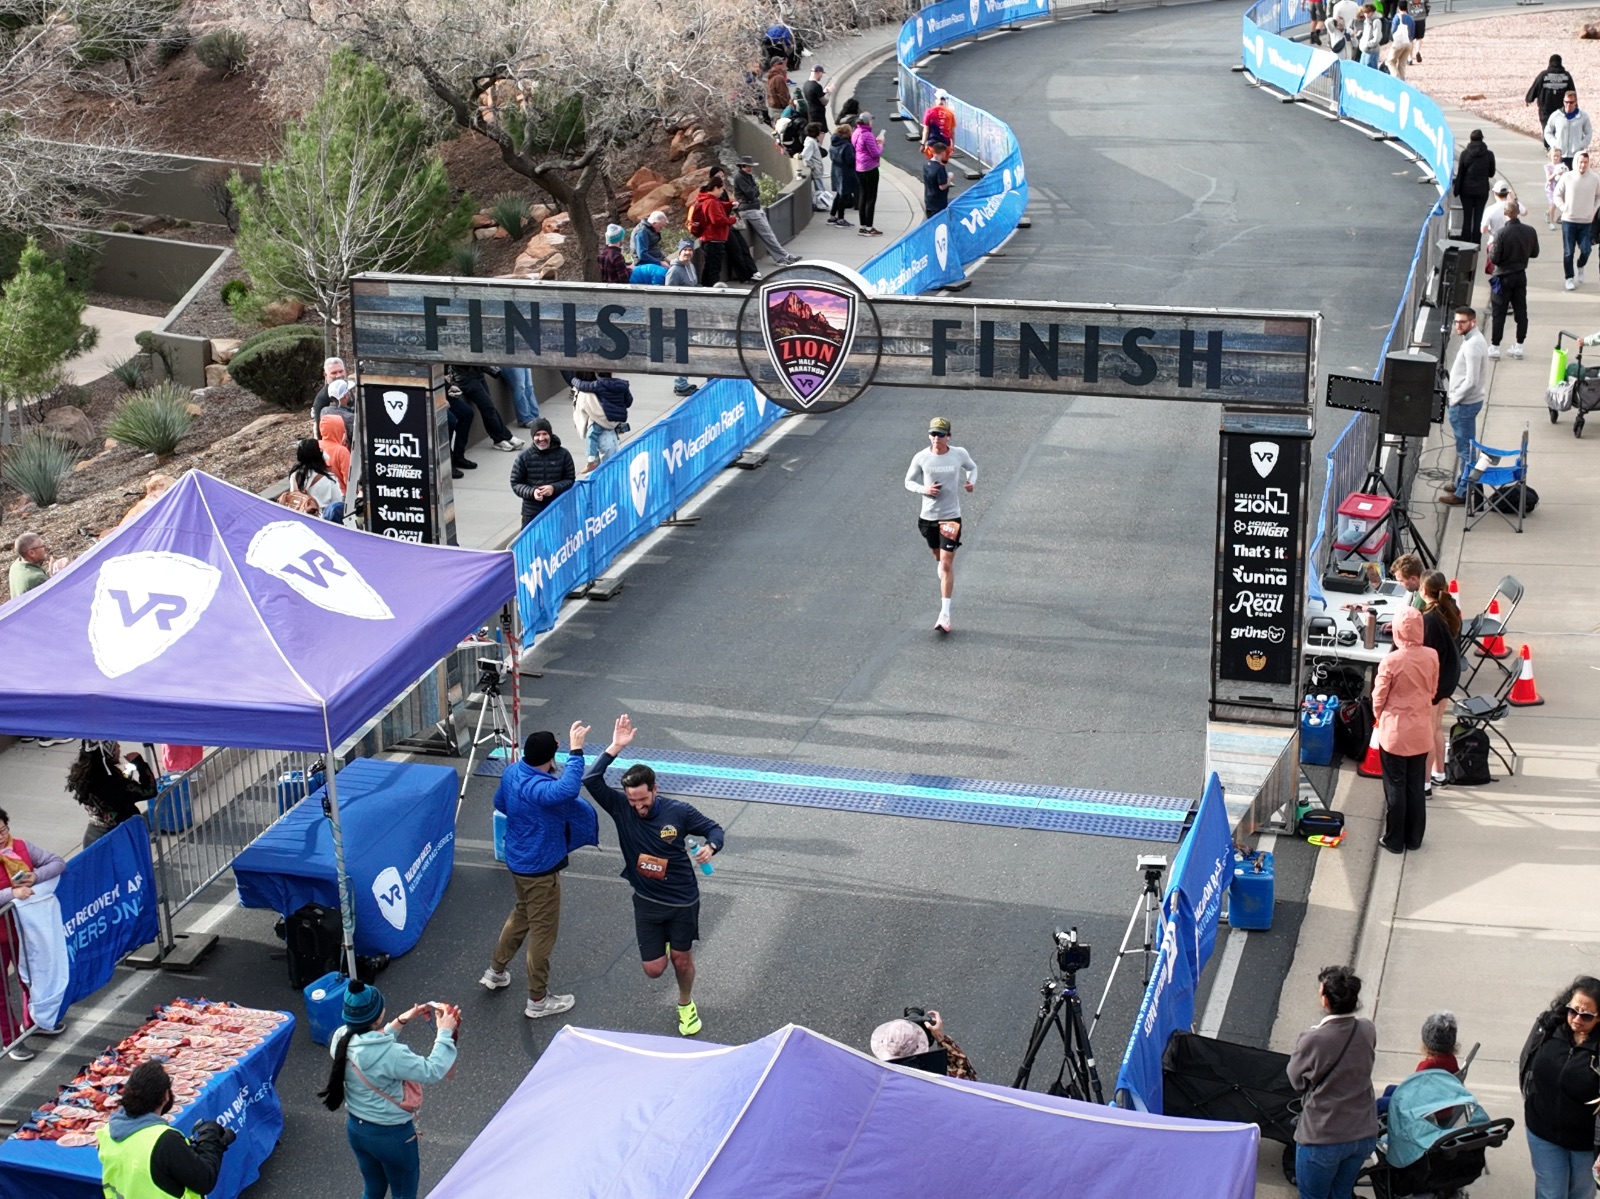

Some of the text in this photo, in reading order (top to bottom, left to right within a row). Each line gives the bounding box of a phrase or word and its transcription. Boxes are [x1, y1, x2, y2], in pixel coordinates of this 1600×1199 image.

[960, 208, 986, 234] VR
[937, 239, 946, 252] VR
[911, 254, 928, 278] Races
[424, 296, 689, 364] FINISH
[780, 340, 834, 362] ZION
[931, 319, 1223, 389] FINISH
[798, 358, 815, 366] HALF
[788, 366, 826, 376] MARATHON
[797, 378, 814, 388] VR
[387, 400, 403, 410] VR
[662, 401, 745, 474] VR Vacation Races
[374, 444, 412, 457] ZION
[1254, 452, 1273, 462] VR
[386, 469, 422, 479] STINGER
[632, 470, 647, 491] VR
[376, 485, 409, 499] That's
[377, 504, 425, 523] Runna
[1234, 499, 1278, 514] ZION
[1245, 526, 1289, 538] STINGER
[520, 503, 617, 598] VR Vacation Races
[1233, 544, 1271, 559] That's
[281, 549, 347, 588] VR
[1233, 565, 1288, 586] Runna
[108, 589, 187, 630] VR
[1229, 590, 1284, 617] Real
[1230, 625, 1268, 639] grüns
[640, 862, 663, 872] 2433
[380, 884, 402, 907] VR
